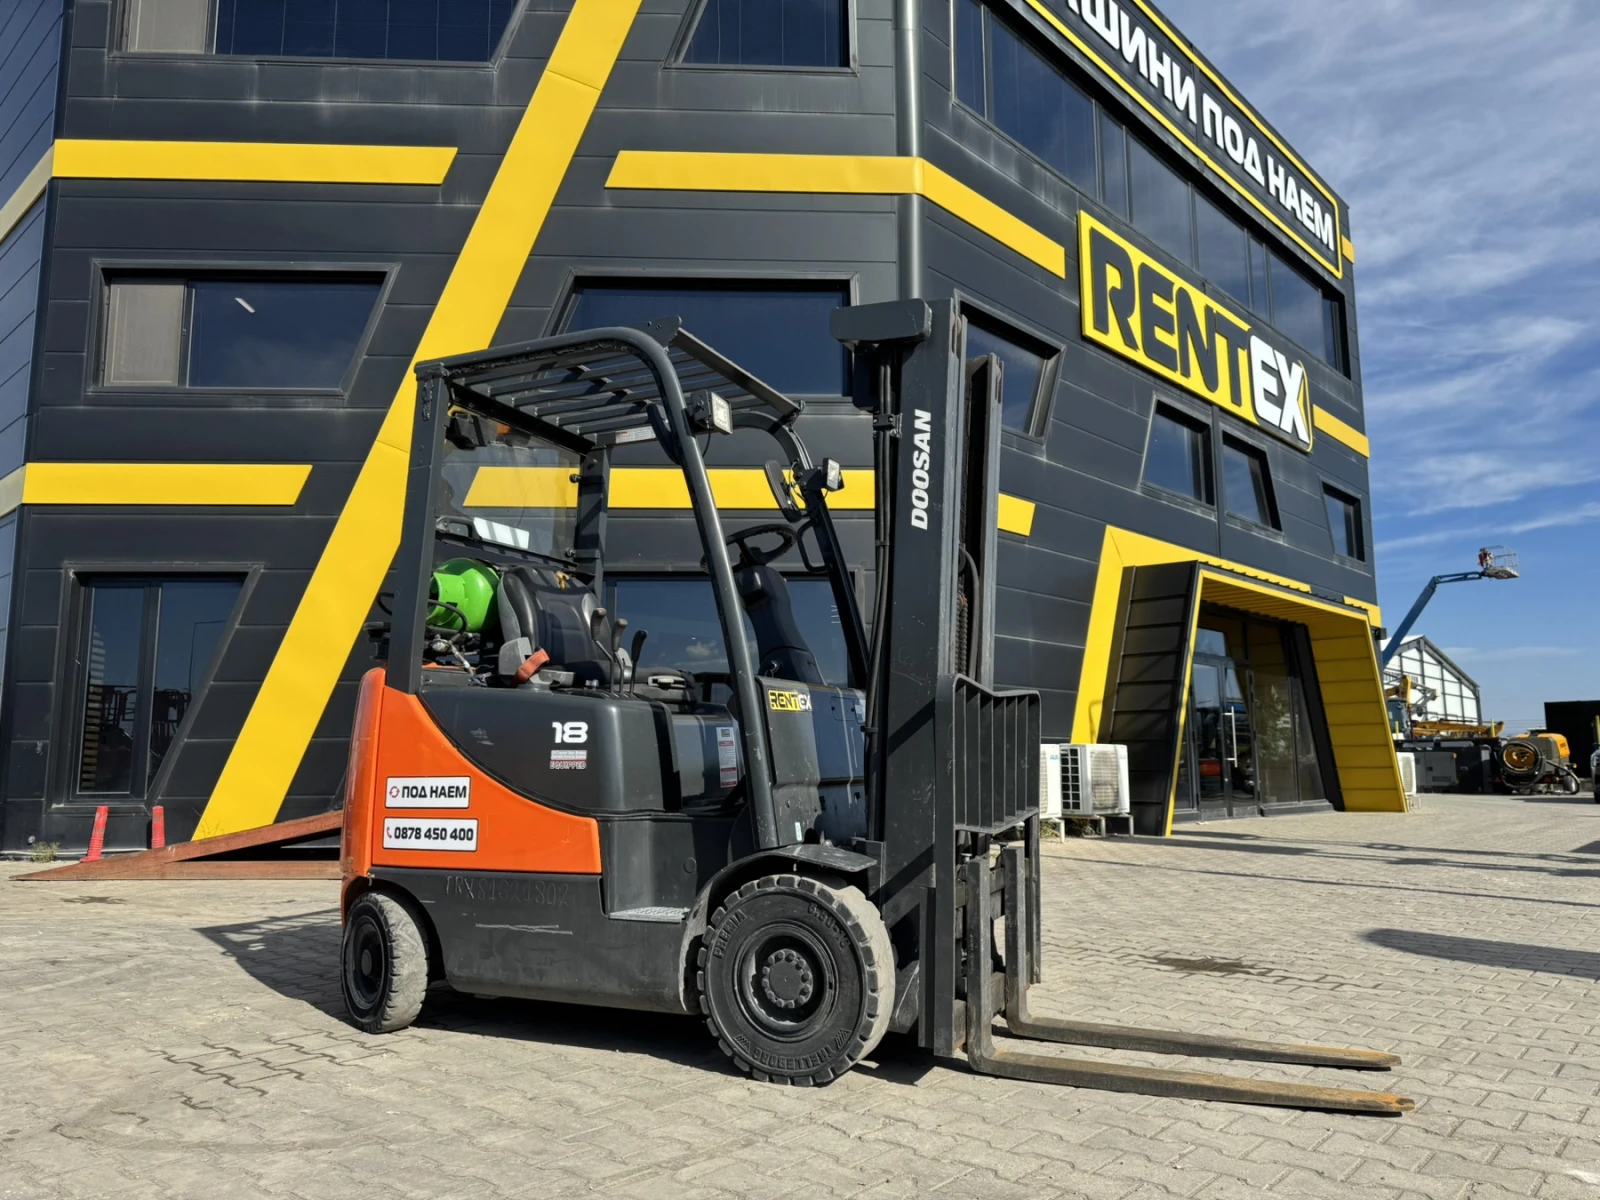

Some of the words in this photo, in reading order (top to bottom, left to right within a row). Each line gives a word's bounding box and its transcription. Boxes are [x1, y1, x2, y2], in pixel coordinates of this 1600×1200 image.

[1067, 0, 1198, 125] ШИНИ
[1202, 92, 1265, 187] ПОД
[1267, 154, 1334, 251] НАЕМ
[1089, 225, 1310, 444] RENTEX
[911, 408, 931, 530] DOOSAN
[769, 692, 812, 710] RENTEX
[552, 721, 589, 744] 18
[401, 785, 428, 799] ПОД
[429, 785, 467, 799] НАЕМ
[393, 826, 422, 840] 0878
[423, 827, 447, 841] 450
[449, 828, 474, 842] 400
